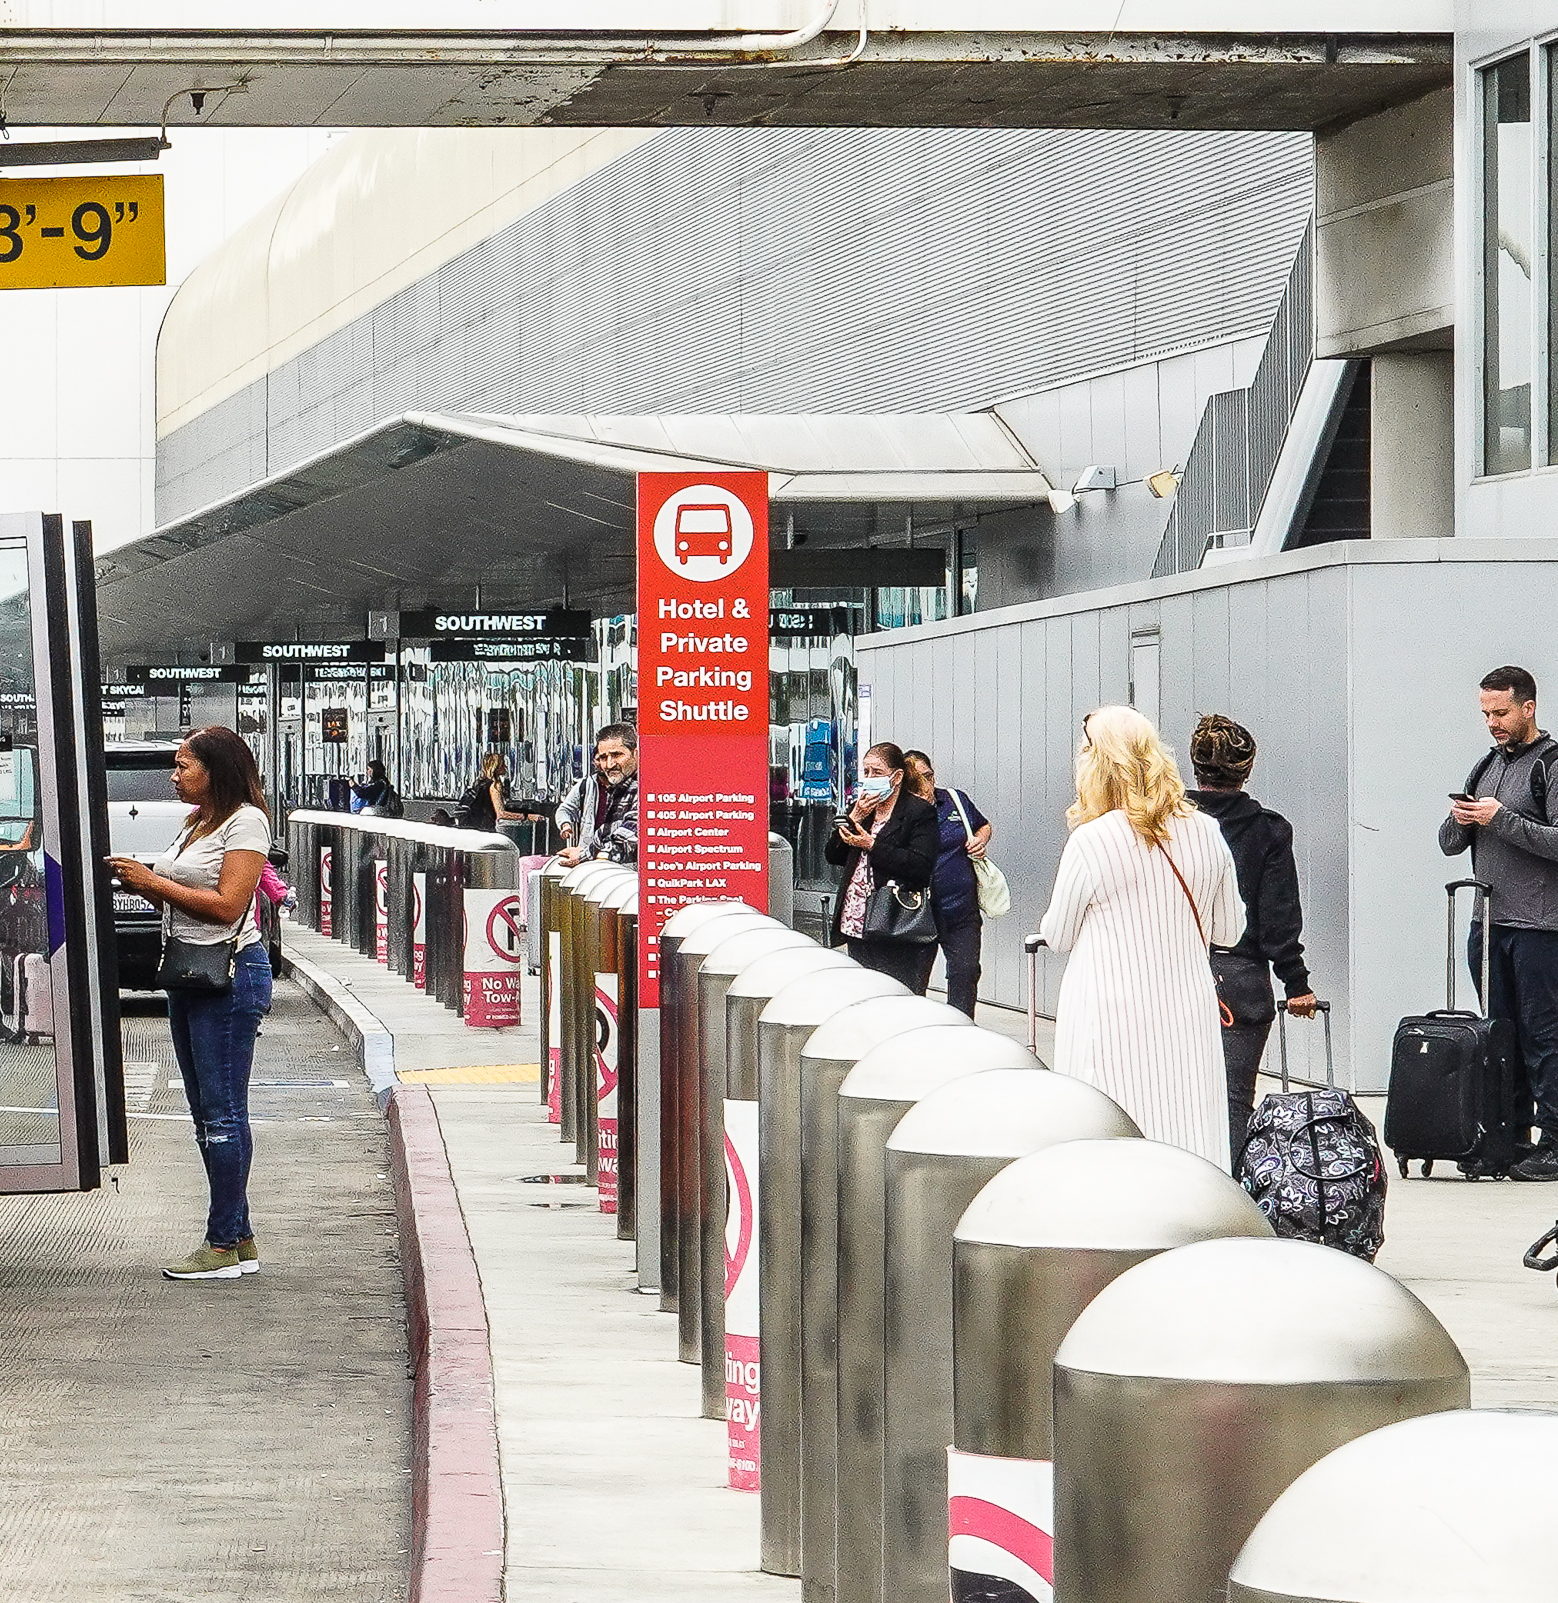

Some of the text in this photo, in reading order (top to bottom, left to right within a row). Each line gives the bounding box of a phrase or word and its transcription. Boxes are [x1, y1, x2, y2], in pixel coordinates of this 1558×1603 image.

[658, 598, 751, 619] Hotel &
[435, 615, 546, 631] SOUTHWEST
[660, 633, 748, 653] Private
[262, 644, 350, 659] SOUTHWEST
[149, 668, 222, 679] SOUTHWEST
[656, 666, 752, 692] Parking
[0, 693, 35, 703] SOUTH
[659, 700, 749, 721] Shuttle
[657, 793, 755, 804] 105 Airport Parking
[657, 810, 755, 821] 405 Airport Parking
[657, 827, 729, 838] Airport Center
[657, 844, 743, 855] Airport Spectrum
[685, 861, 721, 871] Airport
[723, 861, 762, 871] Parking
[705, 878, 727, 887] LAX
[657, 895, 677, 904] The
[483, 977, 502, 990] No
